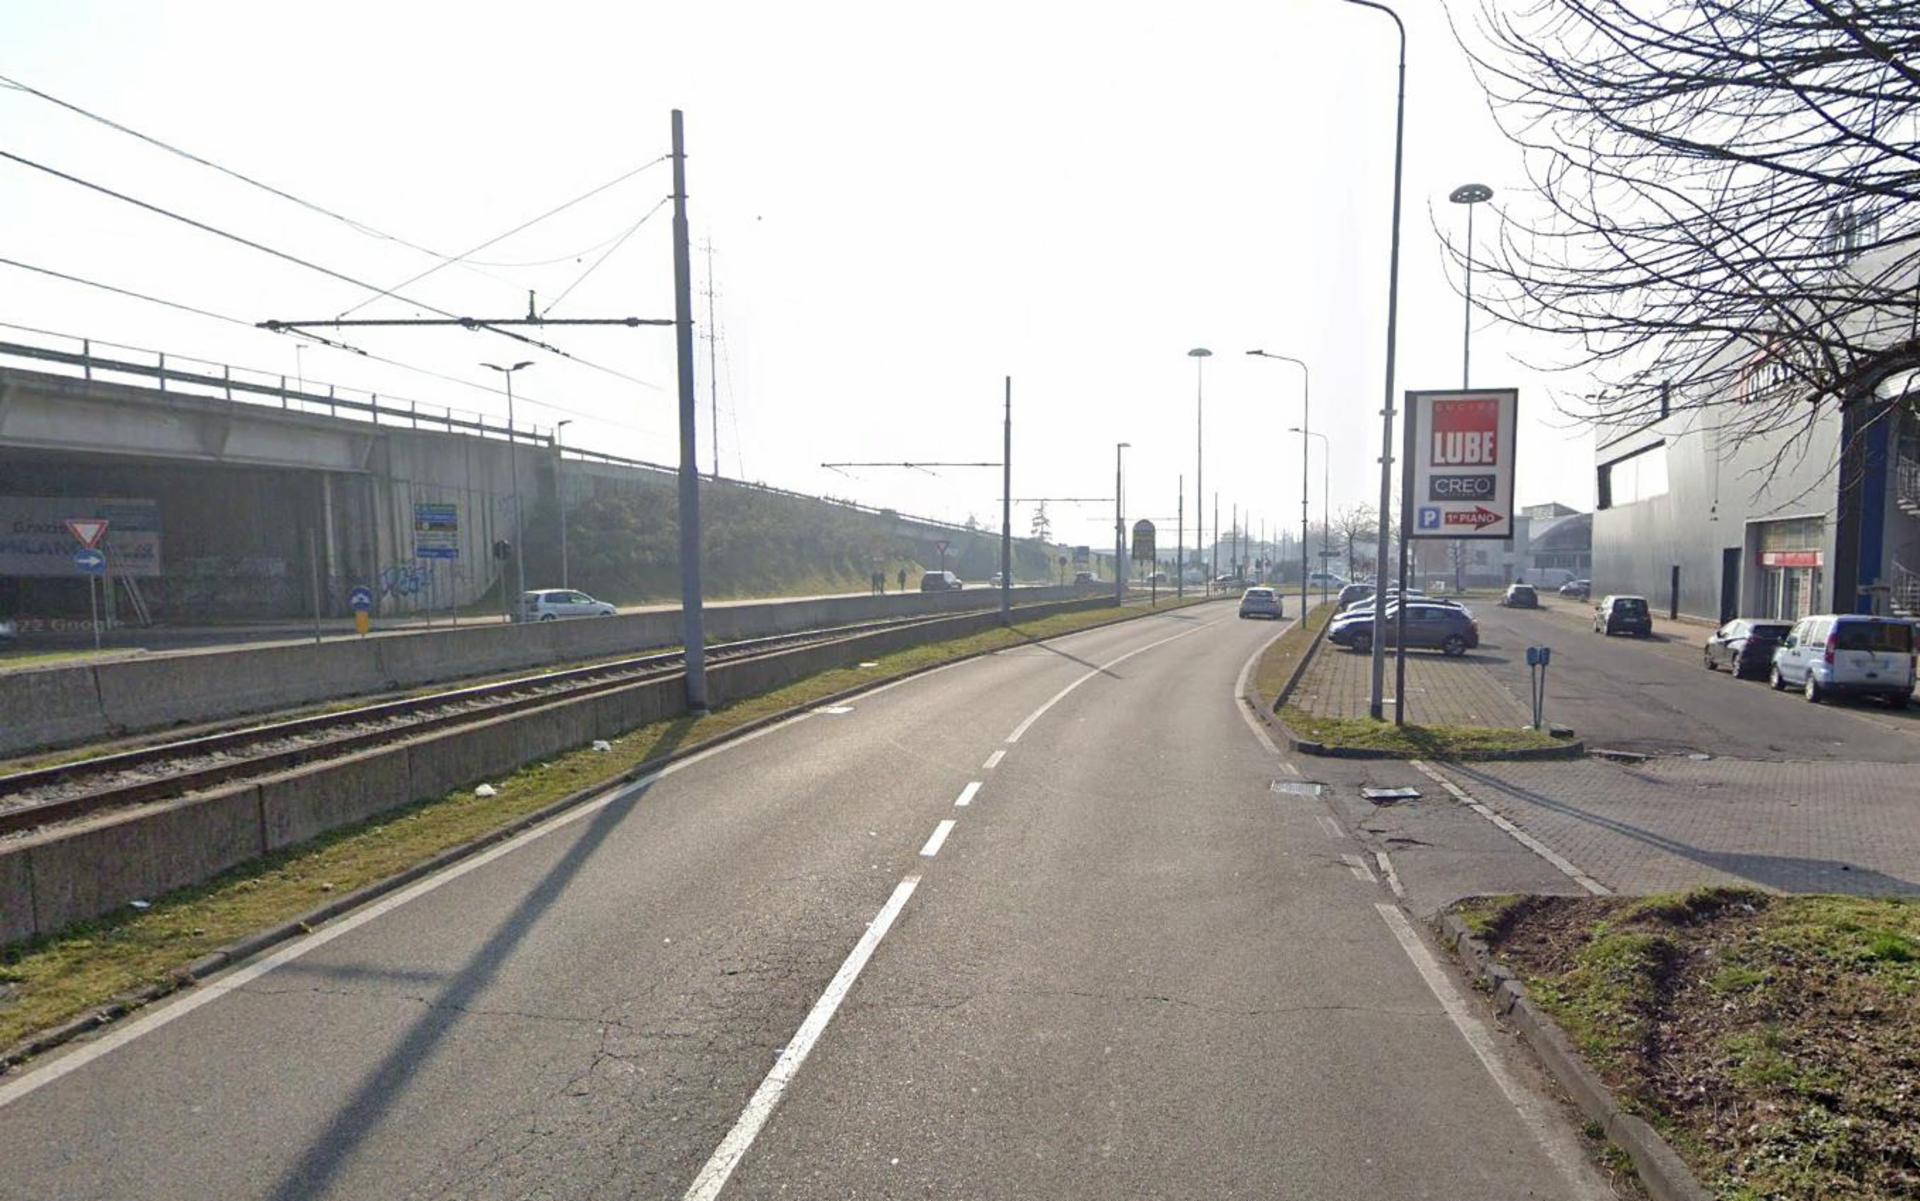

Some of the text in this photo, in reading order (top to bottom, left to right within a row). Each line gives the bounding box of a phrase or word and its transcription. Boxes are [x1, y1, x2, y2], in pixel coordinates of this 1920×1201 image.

[1434, 431, 1494, 464] LUBE
[1435, 477, 1490, 493] CREO
[1424, 510, 1437, 527] P
[1459, 513, 1496, 523] PIANO
